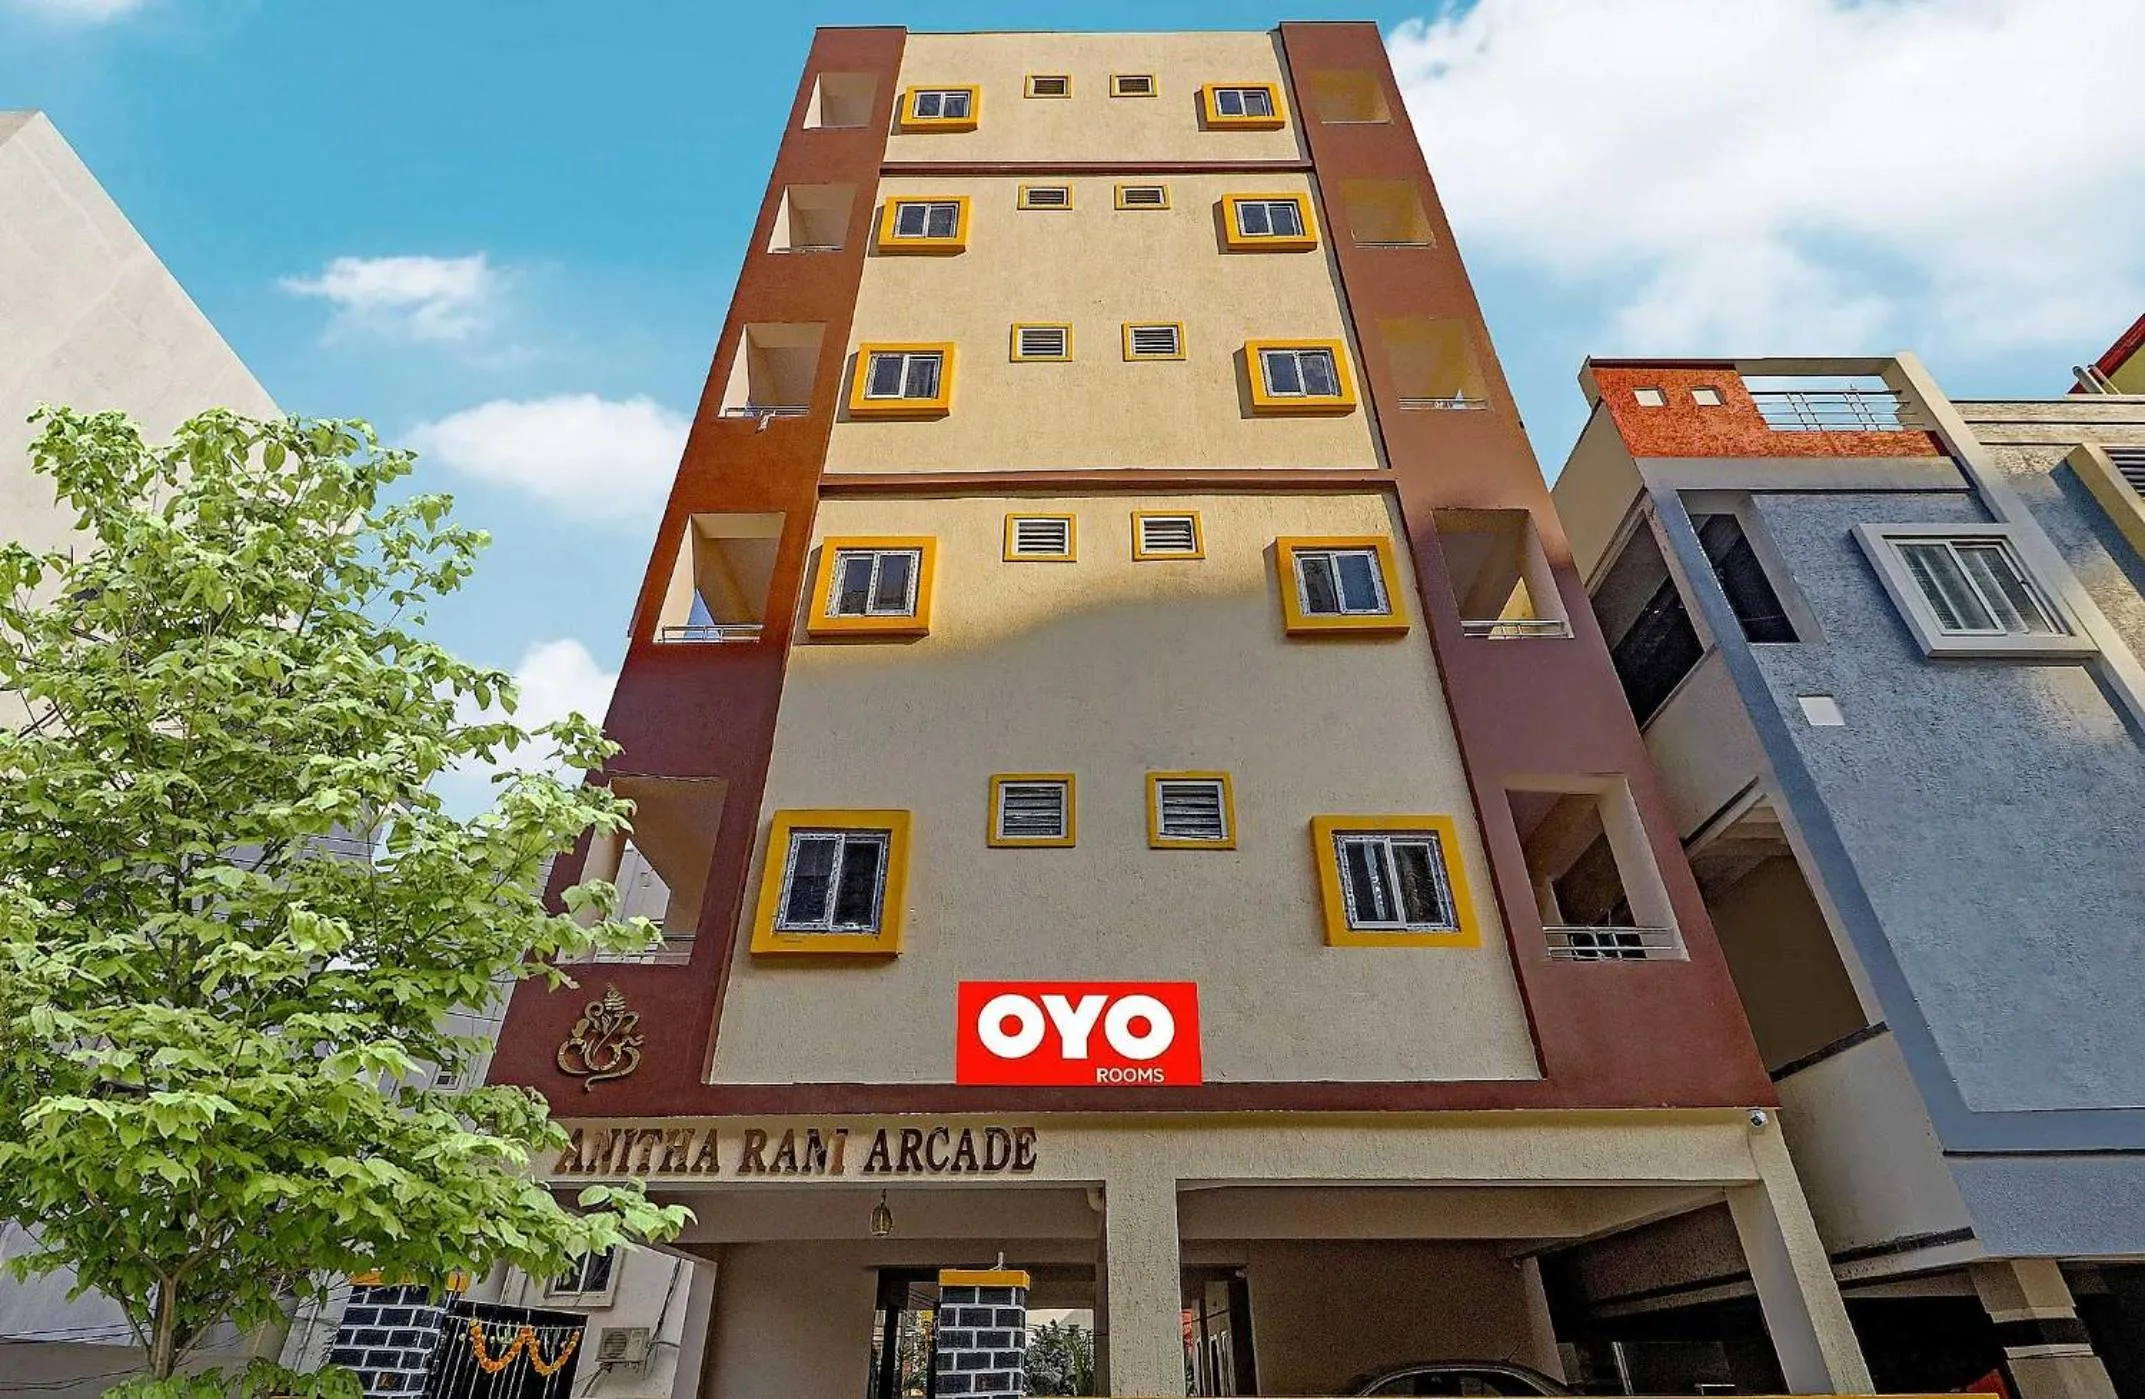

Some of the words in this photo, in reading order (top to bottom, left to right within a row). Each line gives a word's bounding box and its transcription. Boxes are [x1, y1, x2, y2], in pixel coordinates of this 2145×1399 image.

[977, 993, 1175, 1060] OYO
[1096, 1067, 1165, 1083] ROOMS
[552, 1128, 721, 1174] ANITHA
[736, 1128, 849, 1175] RANI
[862, 1127, 1038, 1174] ARCADE
